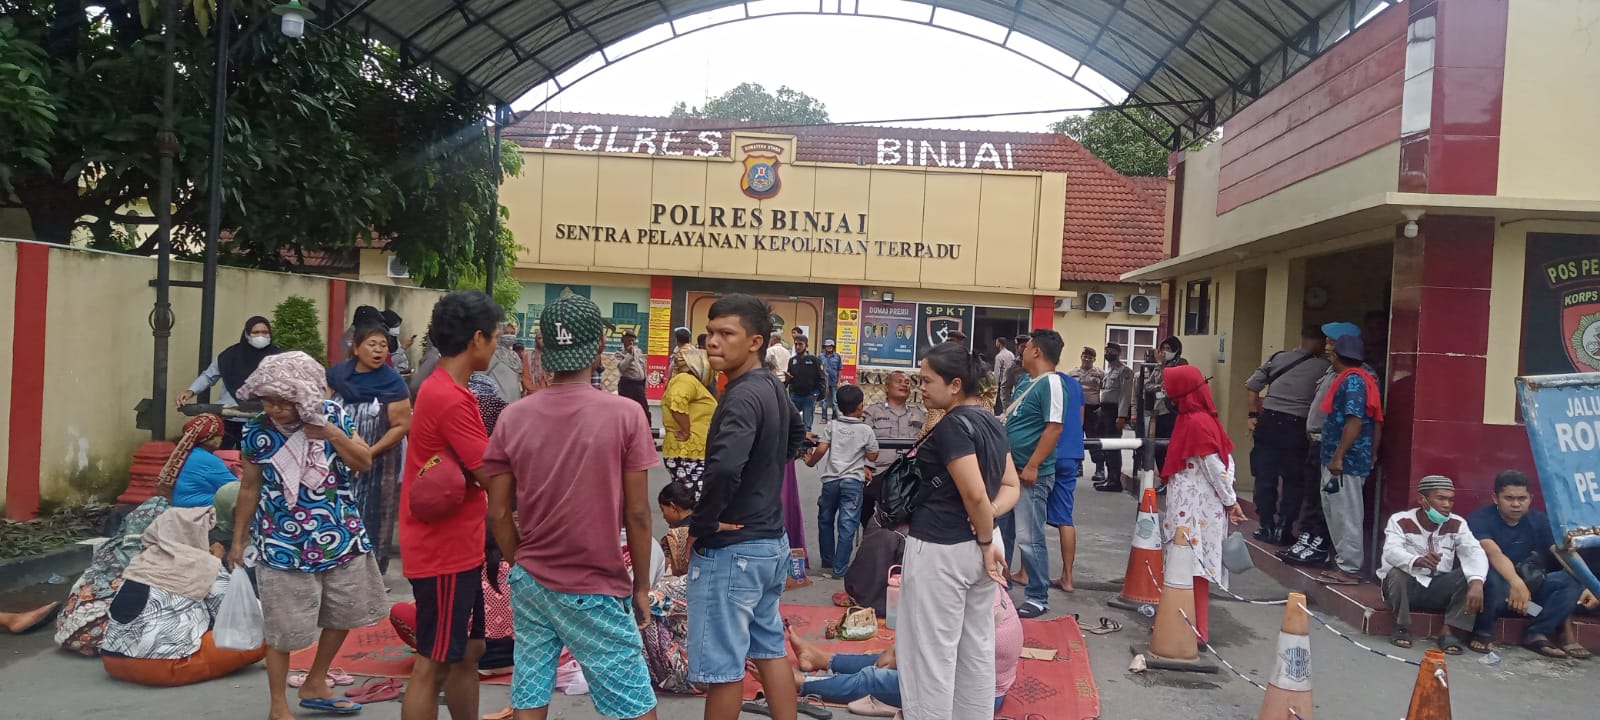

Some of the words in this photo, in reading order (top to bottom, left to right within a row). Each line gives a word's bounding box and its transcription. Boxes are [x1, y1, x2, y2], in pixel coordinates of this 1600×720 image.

[544, 122, 723, 157] POLRES
[877, 138, 1014, 169] BINJAI
[652, 203, 763, 229] POLRES
[771, 209, 868, 235] BINJAI
[555, 223, 632, 244] SENTRA
[636, 228, 748, 250] PELAYANAN
[753, 235, 869, 256] KEPOLISIAN
[874, 240, 961, 260] TERPADU
[1547, 261, 1577, 284] POS
[1564, 290, 1598, 306] KORPS
[555, 322, 573, 345] LA
